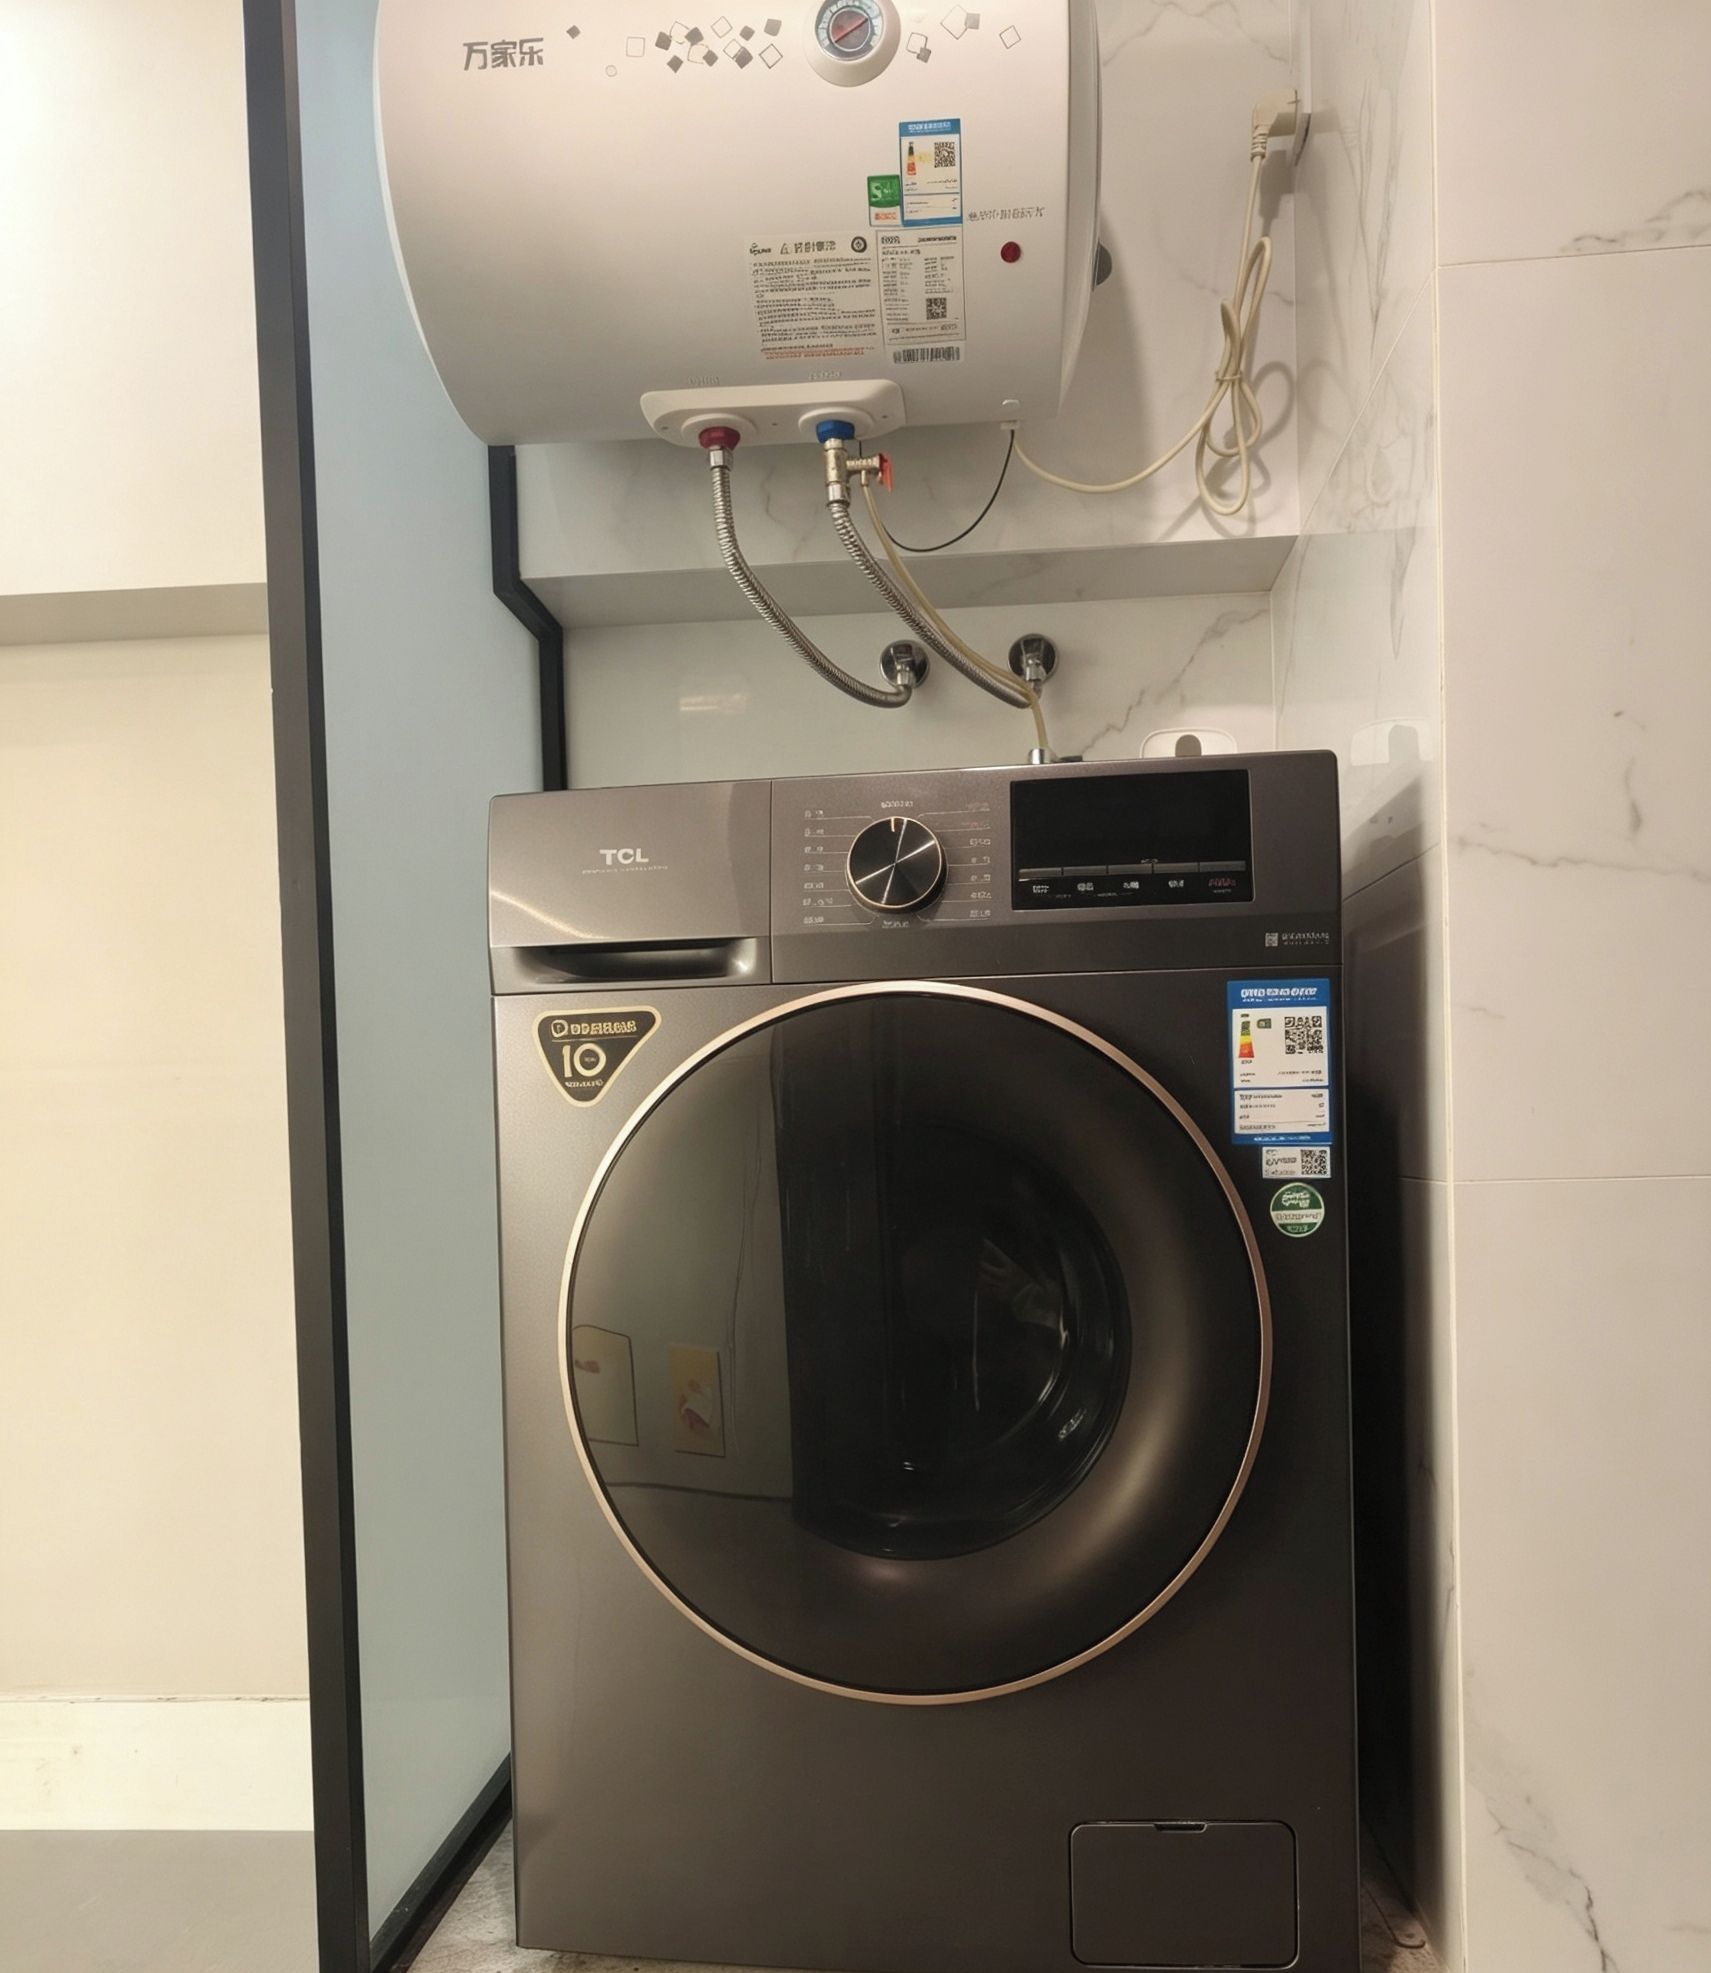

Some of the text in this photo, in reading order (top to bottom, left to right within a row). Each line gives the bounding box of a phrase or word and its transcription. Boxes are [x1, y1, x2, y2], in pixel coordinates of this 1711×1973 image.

[463, 37, 544, 71] 万家乐
[599, 848, 649, 866] TCL
[561, 1042, 607, 1078] 10
